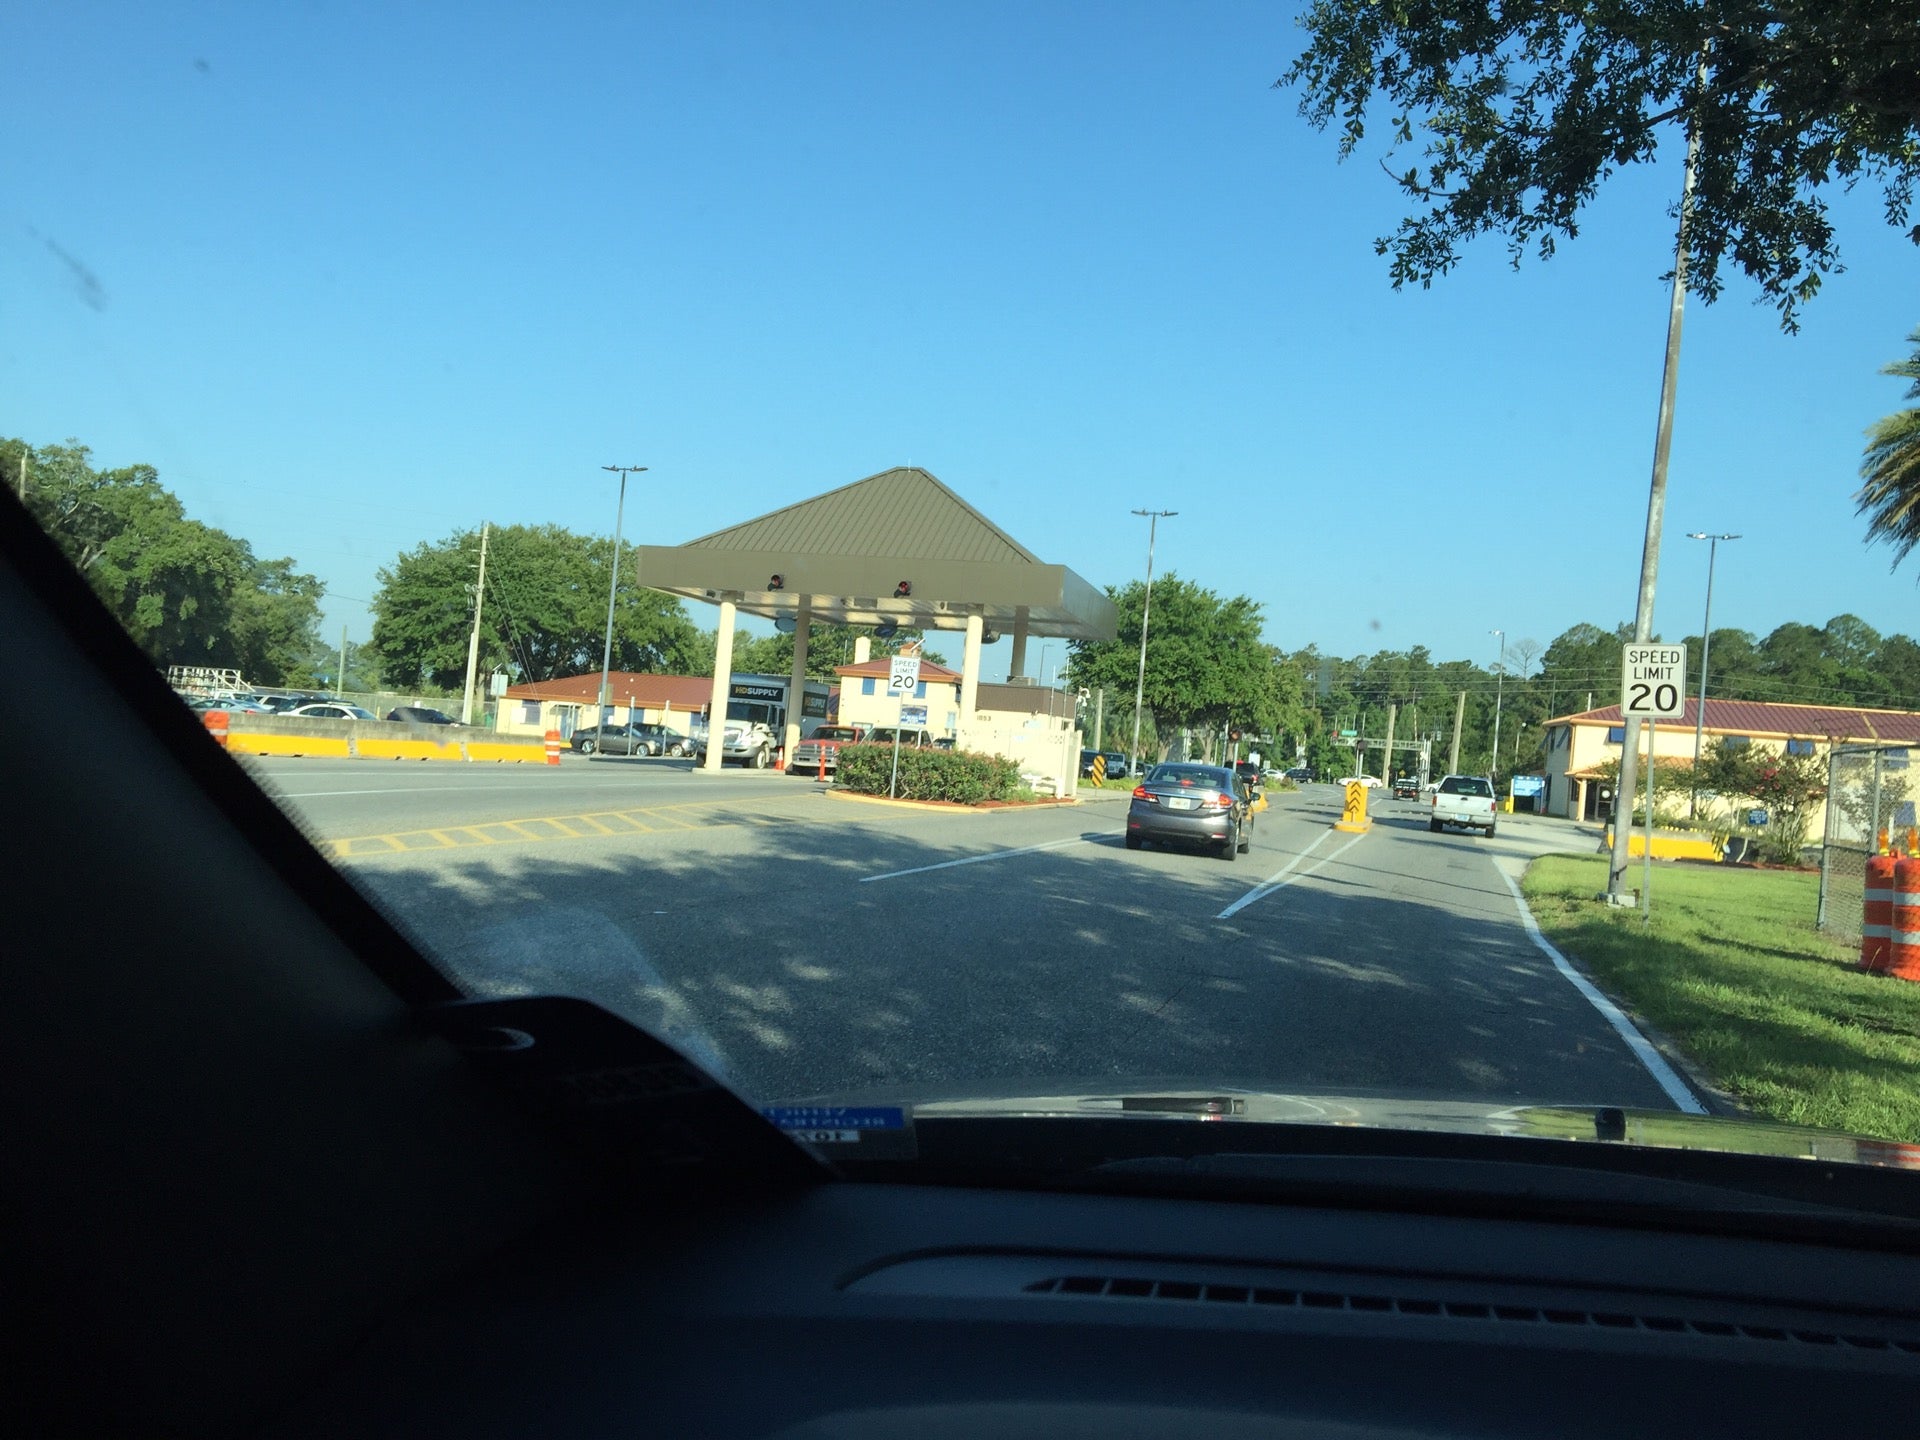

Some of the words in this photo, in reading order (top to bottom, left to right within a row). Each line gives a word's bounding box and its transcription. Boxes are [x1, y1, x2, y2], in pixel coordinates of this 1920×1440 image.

[894, 659, 917, 668] SPEED
[1629, 650, 1680, 664] SPEED
[1633, 667, 1674, 680] LIMIT
[892, 675, 915, 689] 20
[1629, 683, 1678, 712] 20
